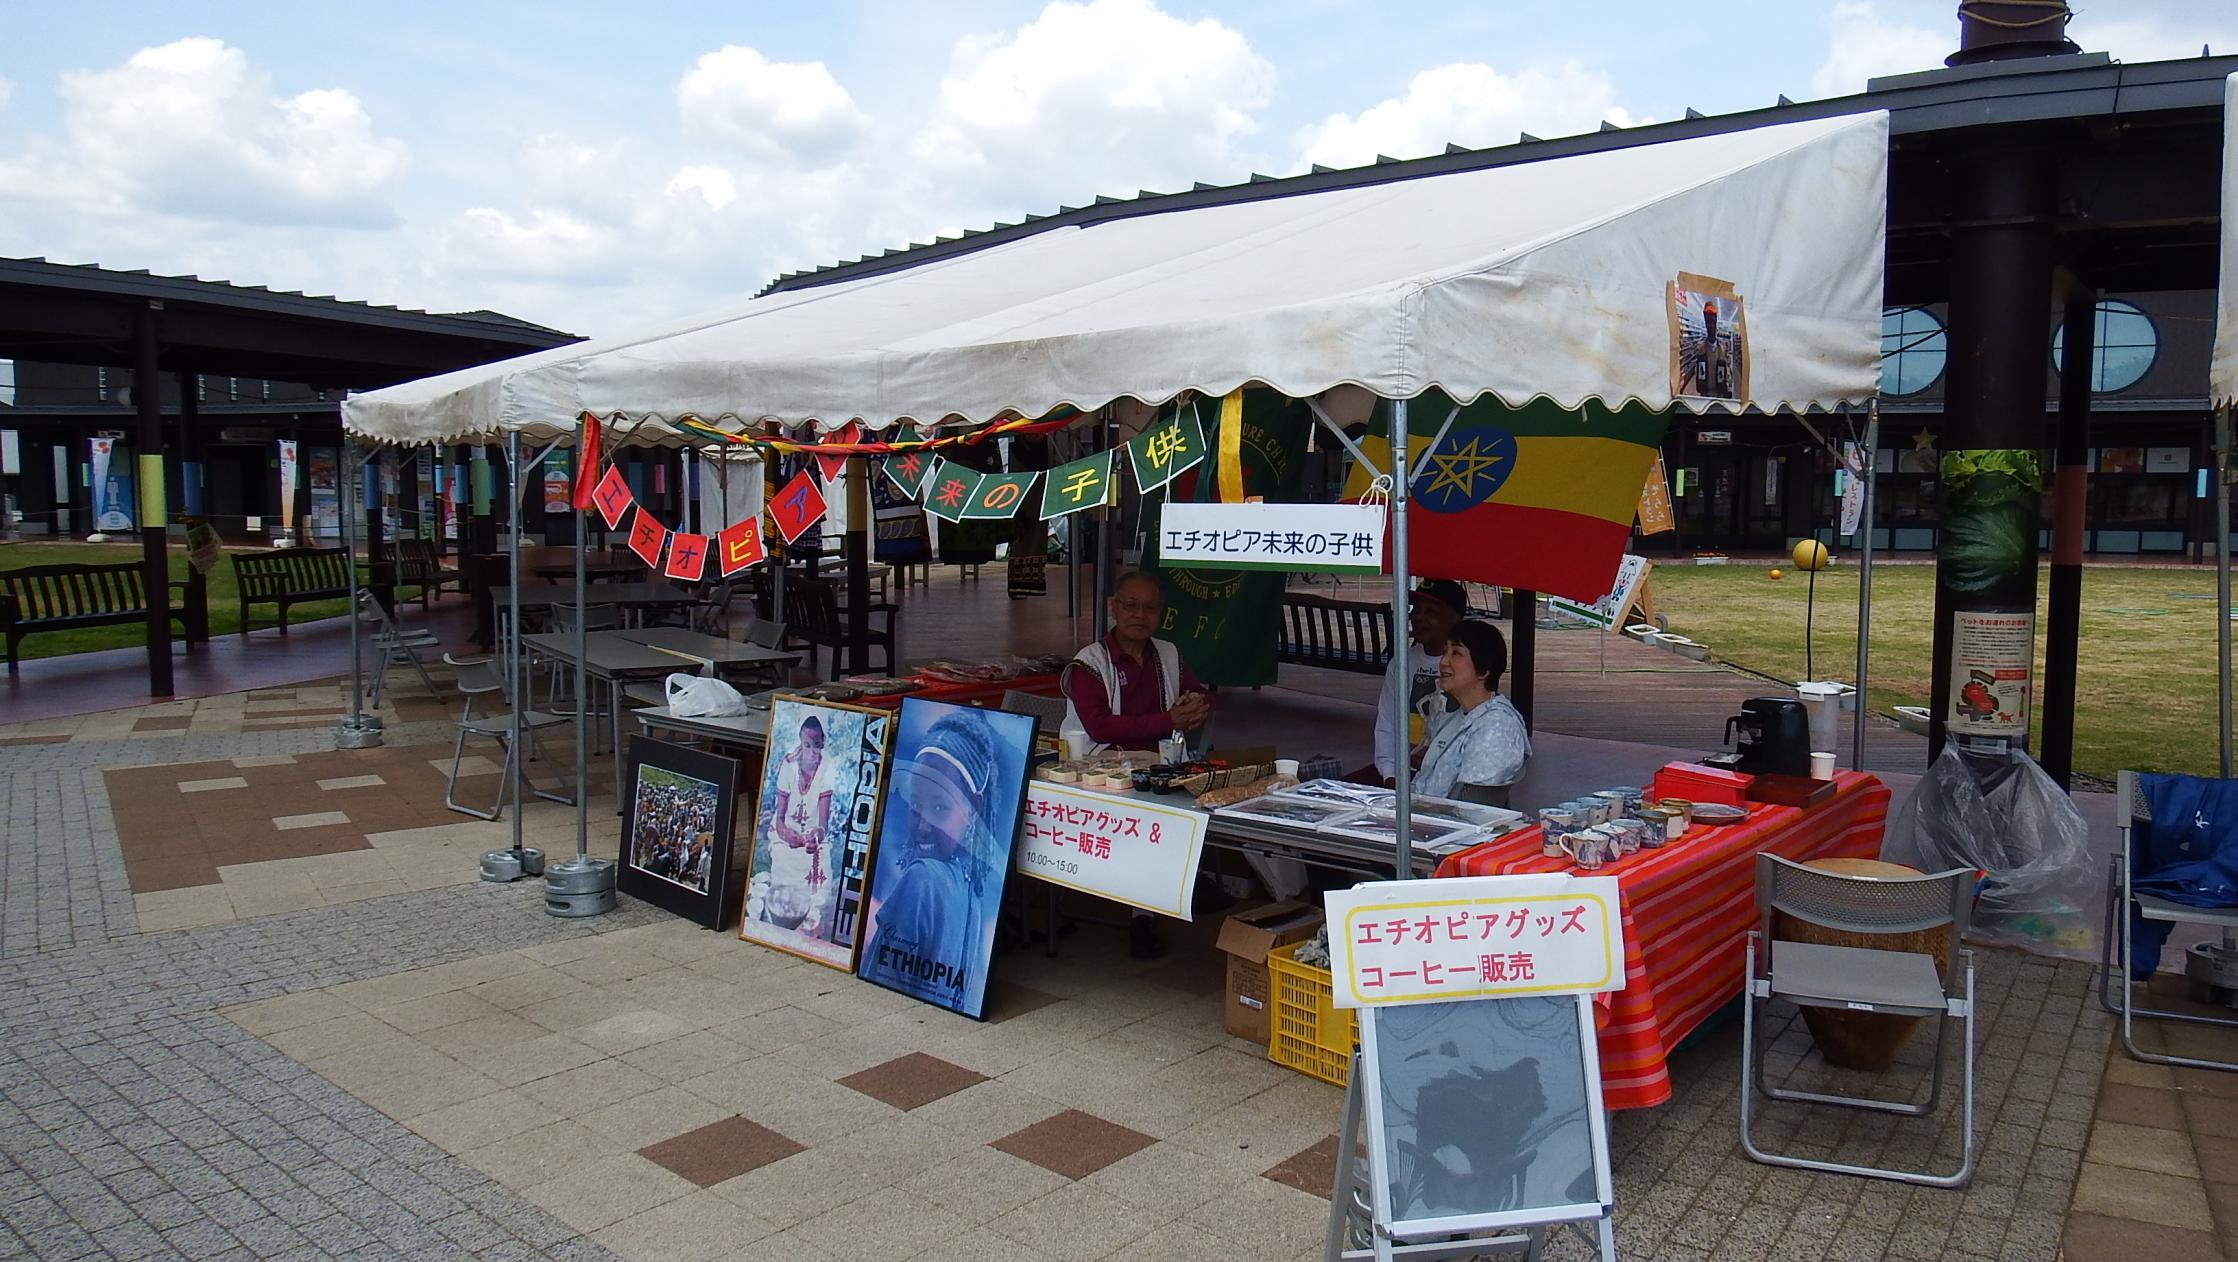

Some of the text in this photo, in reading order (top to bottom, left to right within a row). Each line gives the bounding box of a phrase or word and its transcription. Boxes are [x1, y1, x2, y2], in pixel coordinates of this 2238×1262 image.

[1165, 529, 1374, 557] エチオピア未来の子供
[836, 715, 886, 937] ETHIOPIA
[1024, 799, 1162, 845] エチオピアグッズ &
[1025, 822, 1112, 860] コーヒー販売
[1357, 905, 1587, 945] エチオピアグッズ
[877, 944, 965, 992] ETHIOPIA
[1361, 951, 1536, 987] コーヒー販売
